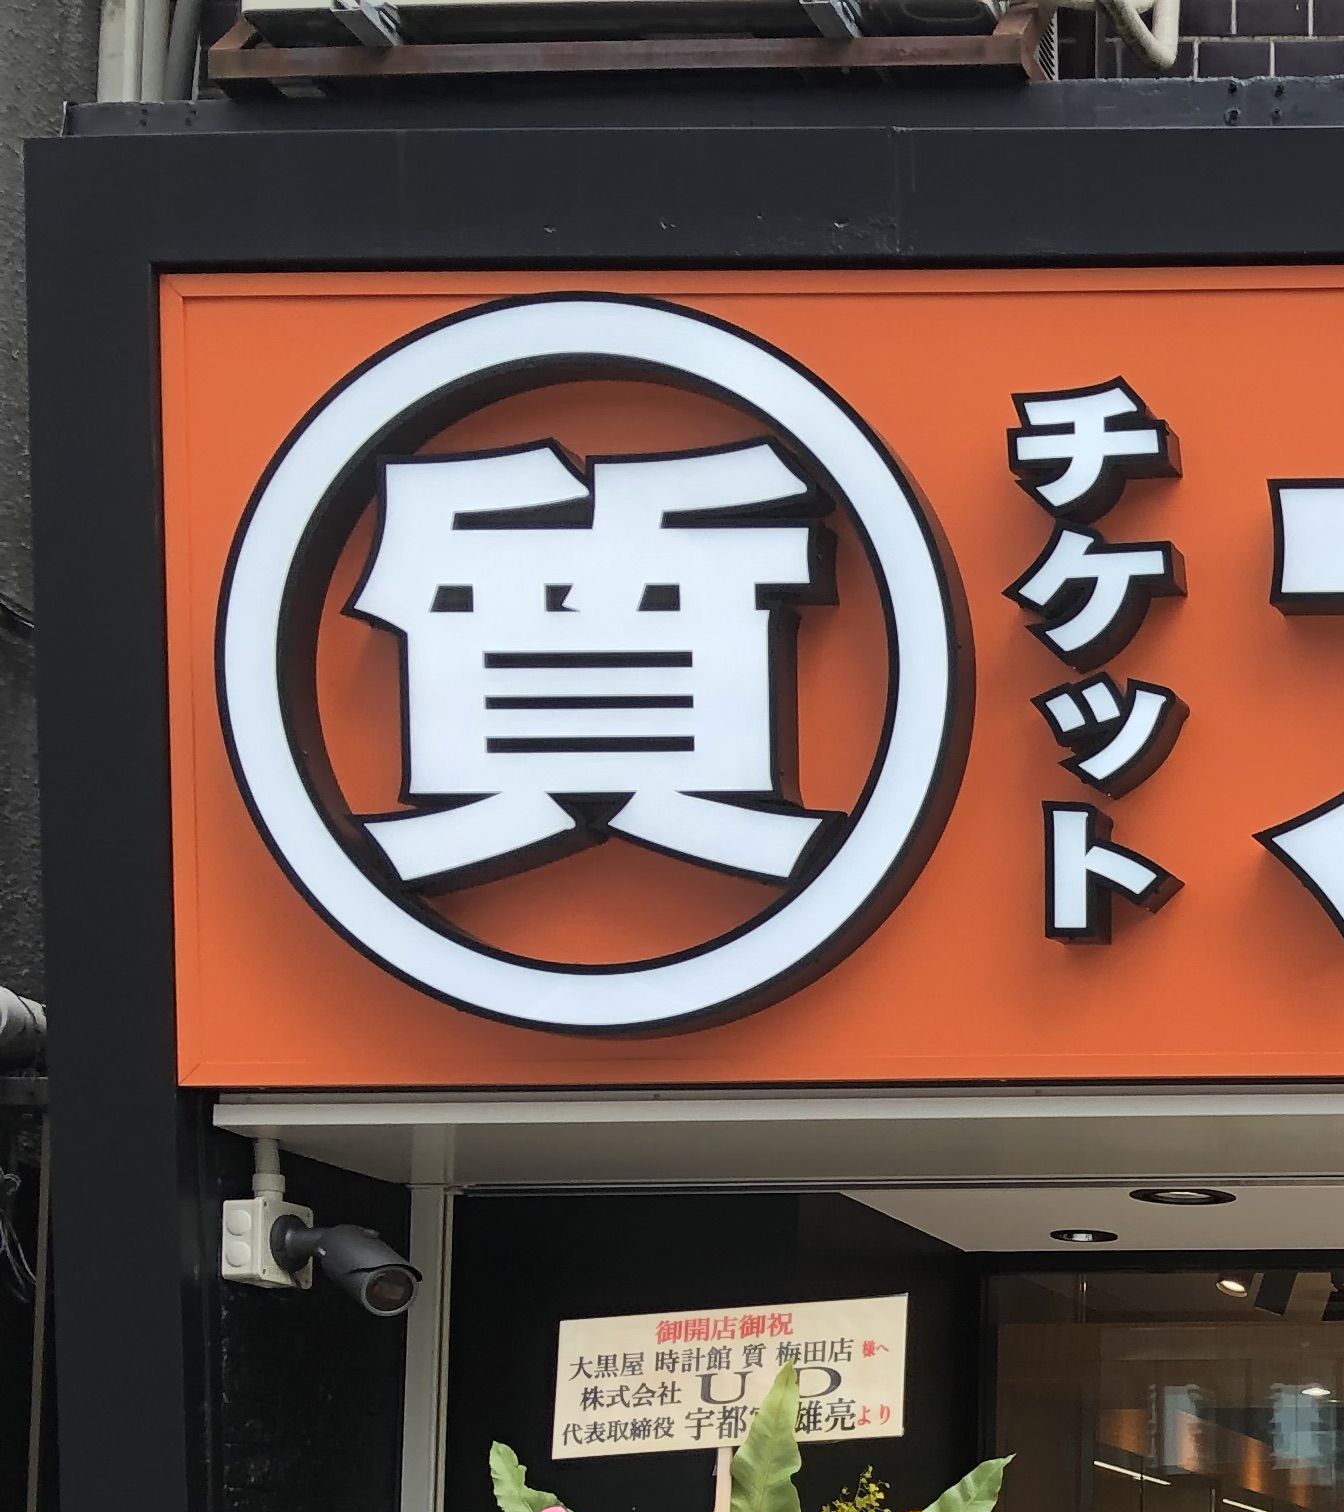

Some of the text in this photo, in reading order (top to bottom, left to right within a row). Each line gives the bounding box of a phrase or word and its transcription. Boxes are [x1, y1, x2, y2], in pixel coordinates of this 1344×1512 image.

[345, 438, 840, 887] 質
[1004, 376, 1186, 940] チケット
[655, 1312, 795, 1345] 御開店御祝
[568, 1351, 645, 1381] 大黒屋
[655, 1345, 733, 1374] 時計館
[743, 1342, 767, 1369] 質
[776, 1337, 855, 1367] 梅田店
[580, 1380, 683, 1412] 株式会社
[562, 1416, 676, 1446] 代表取締役
[685, 1397, 856, 1441] 宇都雄亮
